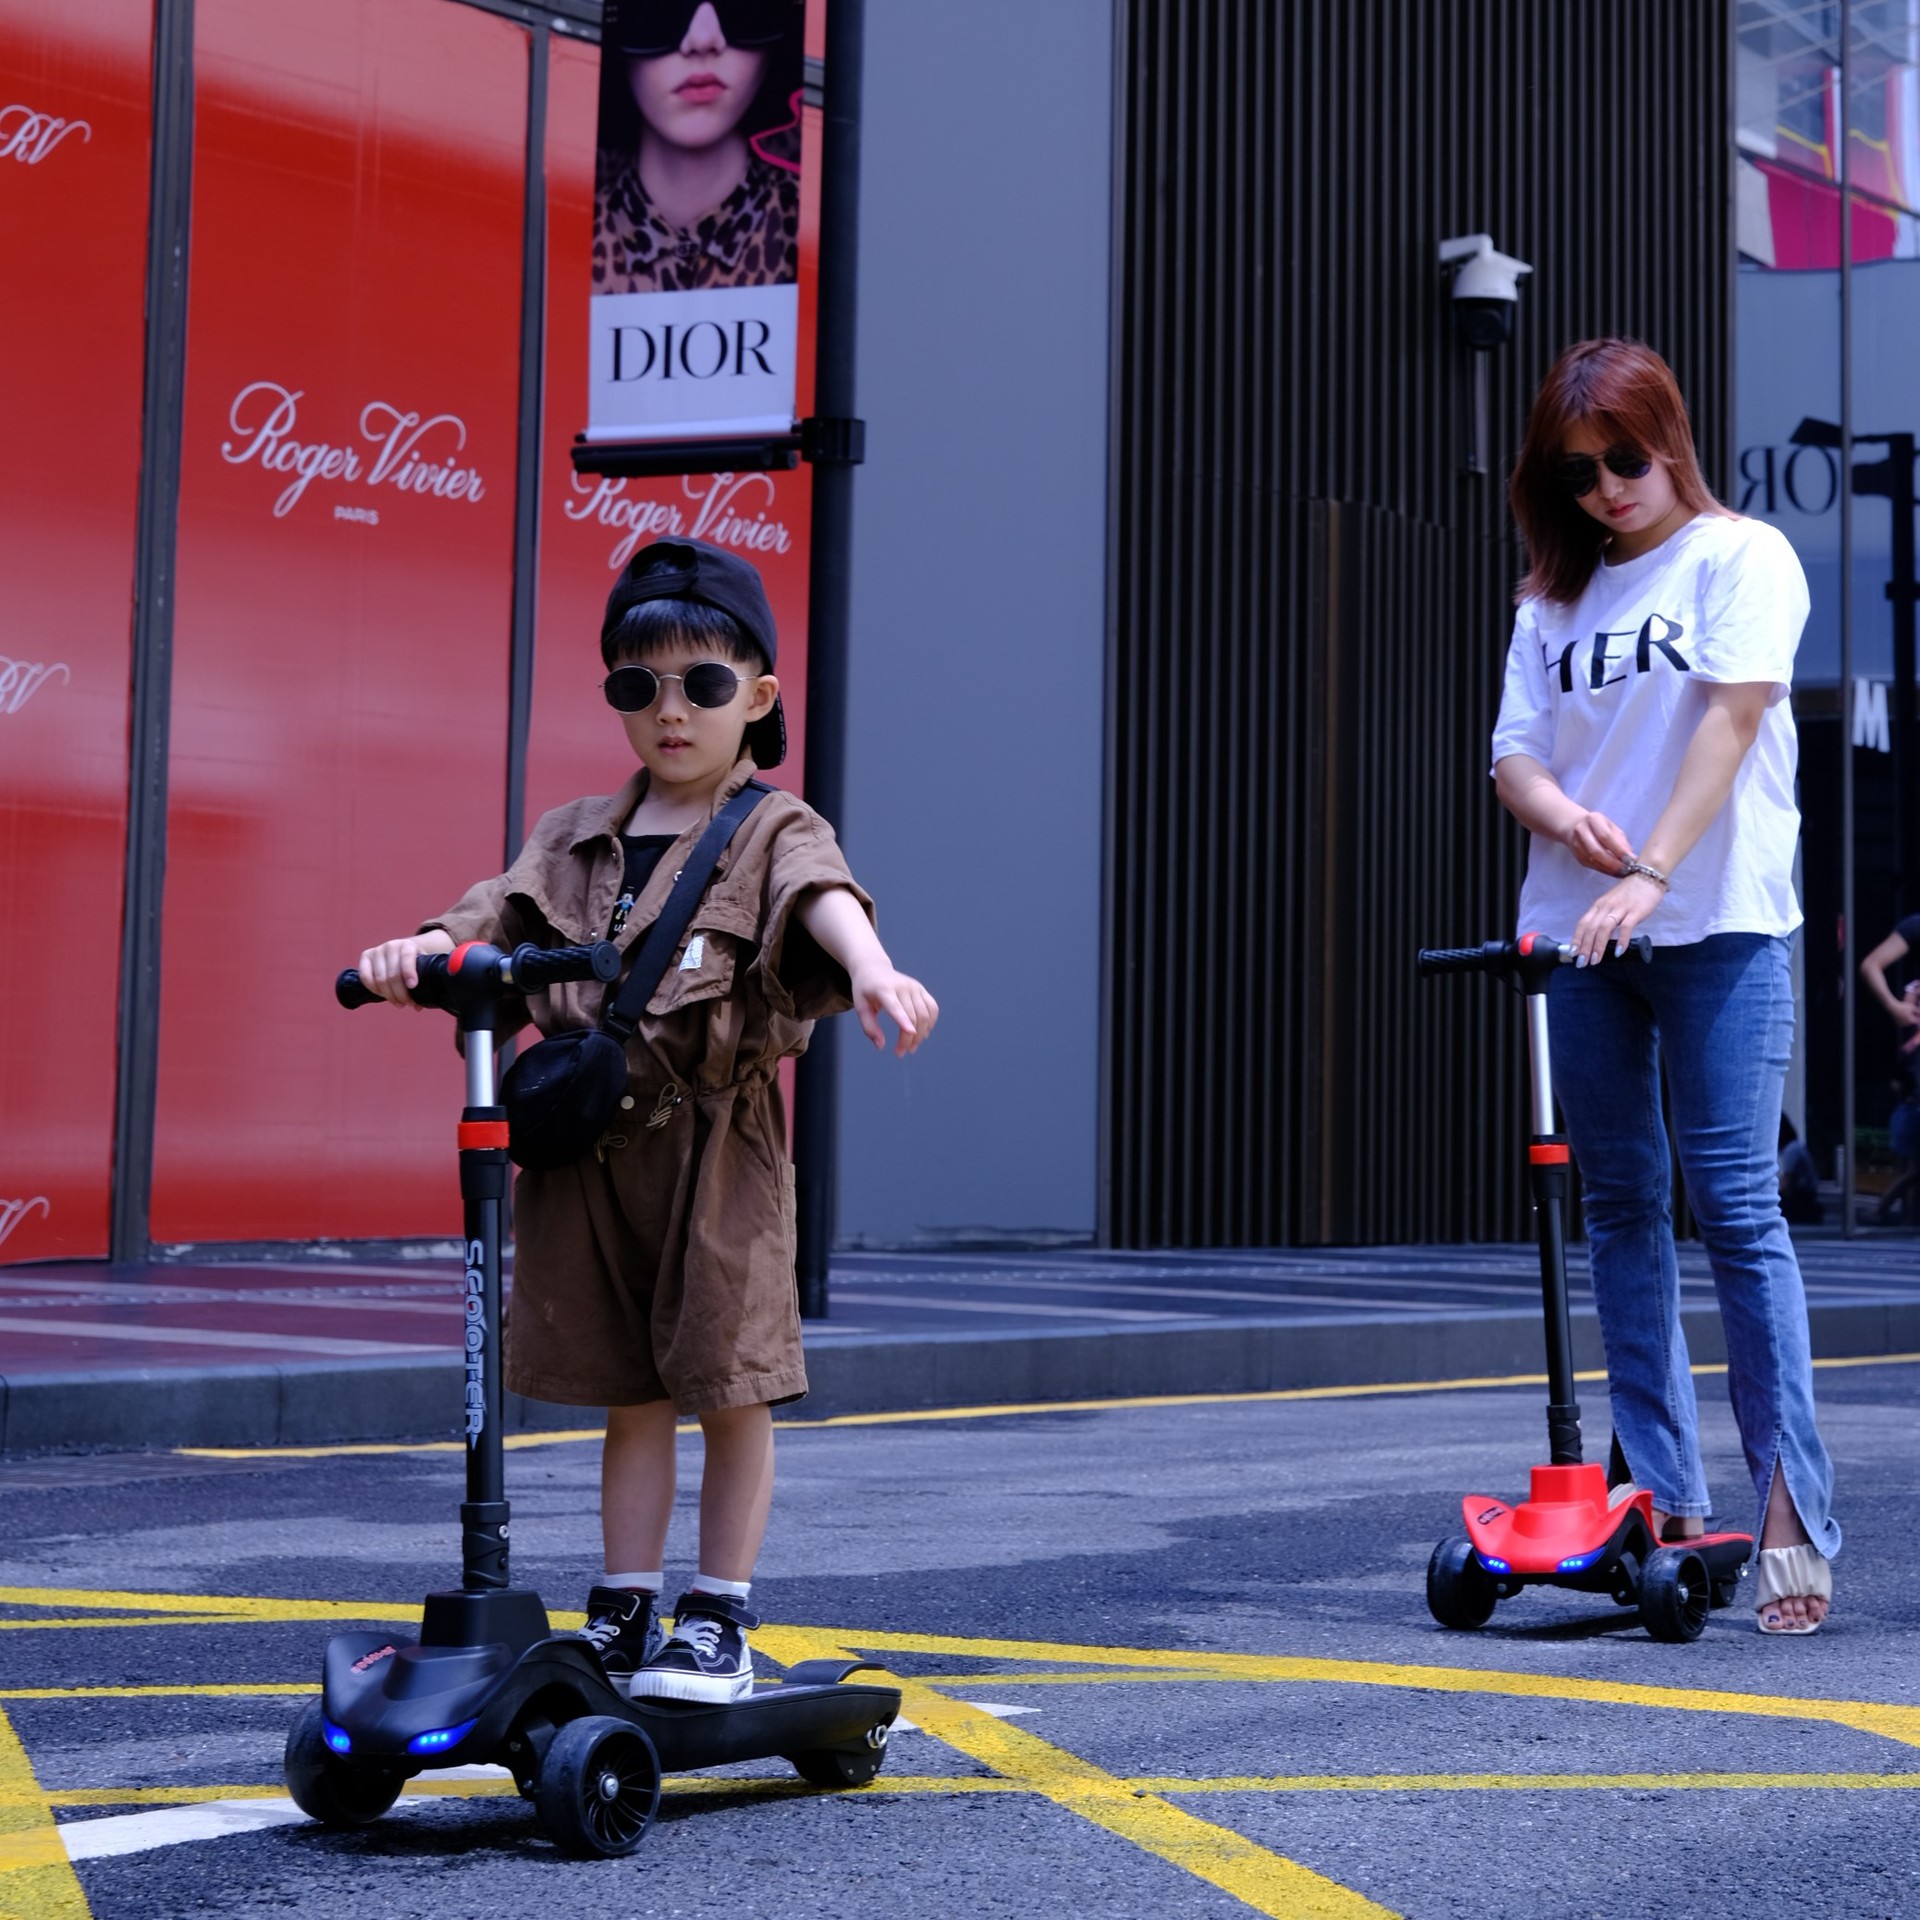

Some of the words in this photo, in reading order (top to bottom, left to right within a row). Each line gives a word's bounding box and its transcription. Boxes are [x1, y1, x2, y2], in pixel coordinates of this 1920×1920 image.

[607, 319, 776, 383] DIOR
[221, 381, 363, 518] Roger
[359, 401, 486, 502] Vivier
[333, 505, 380, 525] PARIS
[564, 470, 686, 569] Roger
[682, 472, 792, 554] Vivier
[1542, 613, 1690, 692] HER
[465, 1239, 488, 1450] SCOOTER
